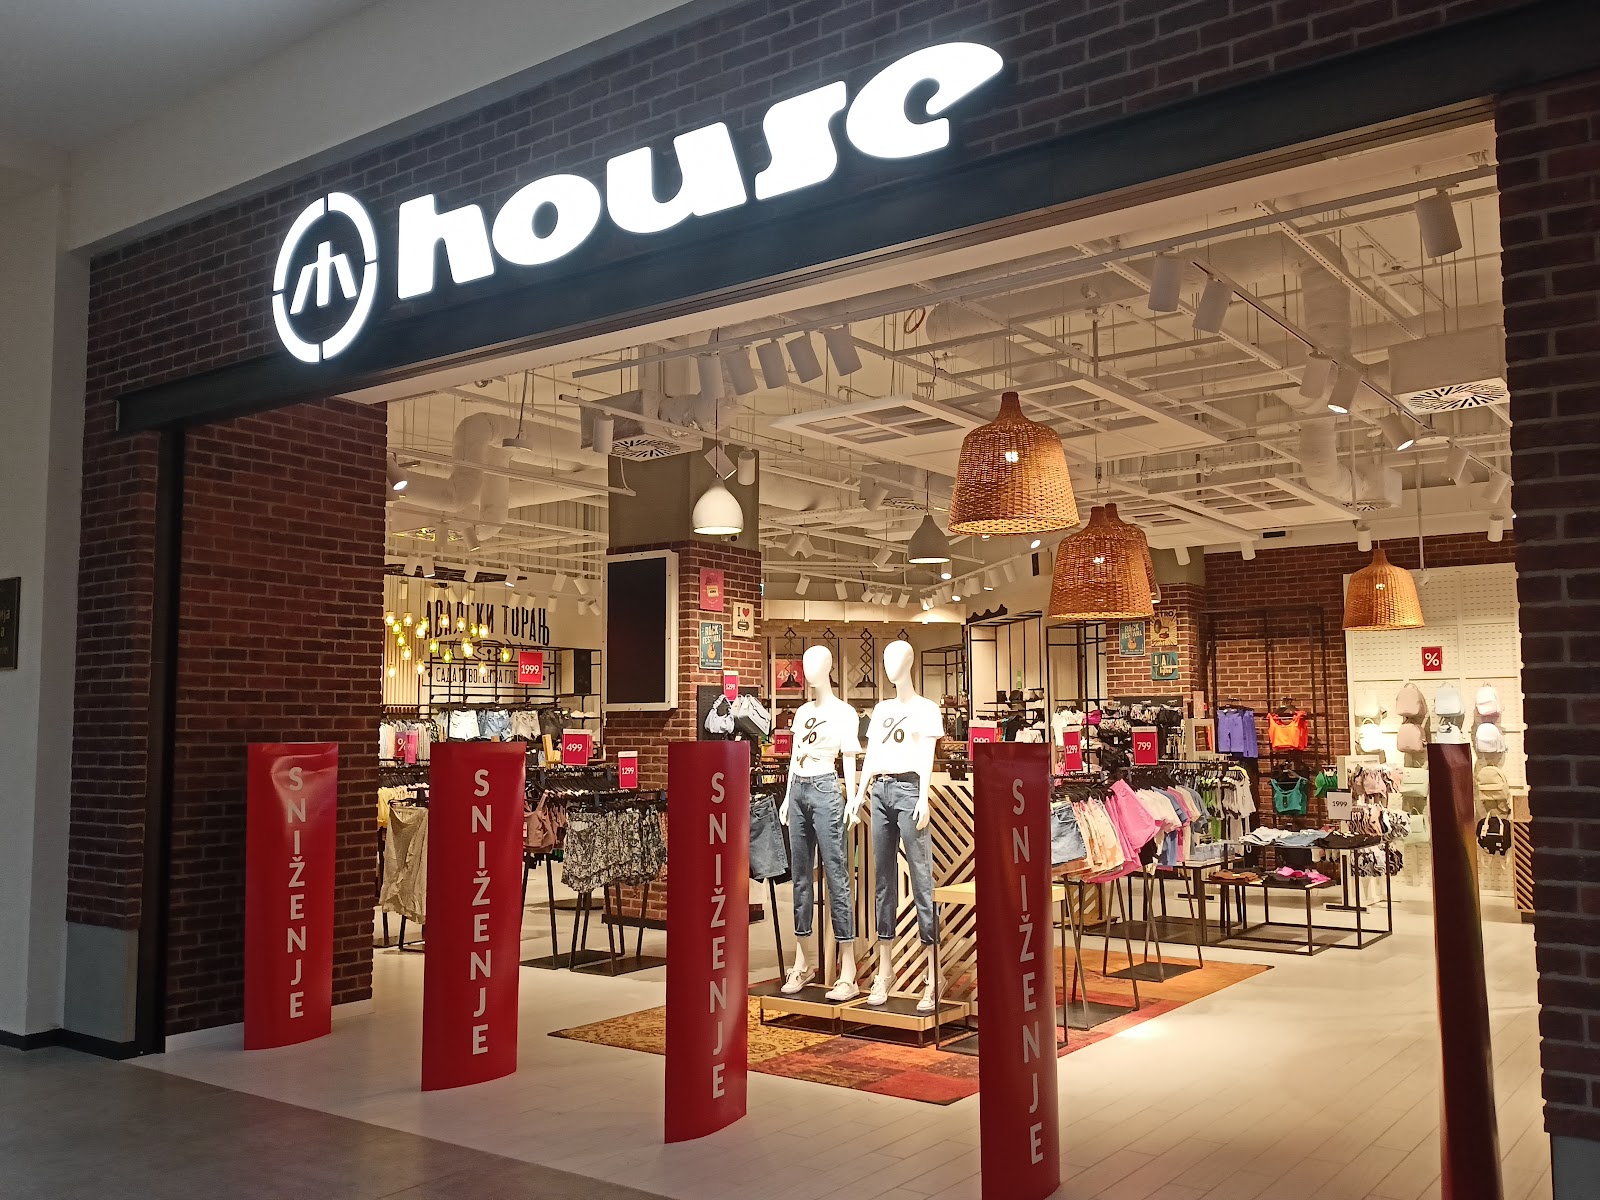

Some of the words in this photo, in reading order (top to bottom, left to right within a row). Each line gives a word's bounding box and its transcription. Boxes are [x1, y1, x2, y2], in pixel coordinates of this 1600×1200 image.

[398, 41, 1004, 300] house
[501, 604, 550, 647] ТОРАЊ
[459, 667, 492, 684] ОТВОЕН
[520, 664, 540, 675] 1999
[566, 743, 583, 752] 499
[1066, 744, 1078, 754] 1299
[1137, 741, 1152, 751] 799
[621, 766, 635, 775] 1299
[287, 766, 307, 1019] SNIŽENJE
[469, 769, 492, 1055] SNIŽENJE
[709, 771, 727, 1099] SNIŽENJE
[1012, 778, 1044, 1165] SNIŽENJE
